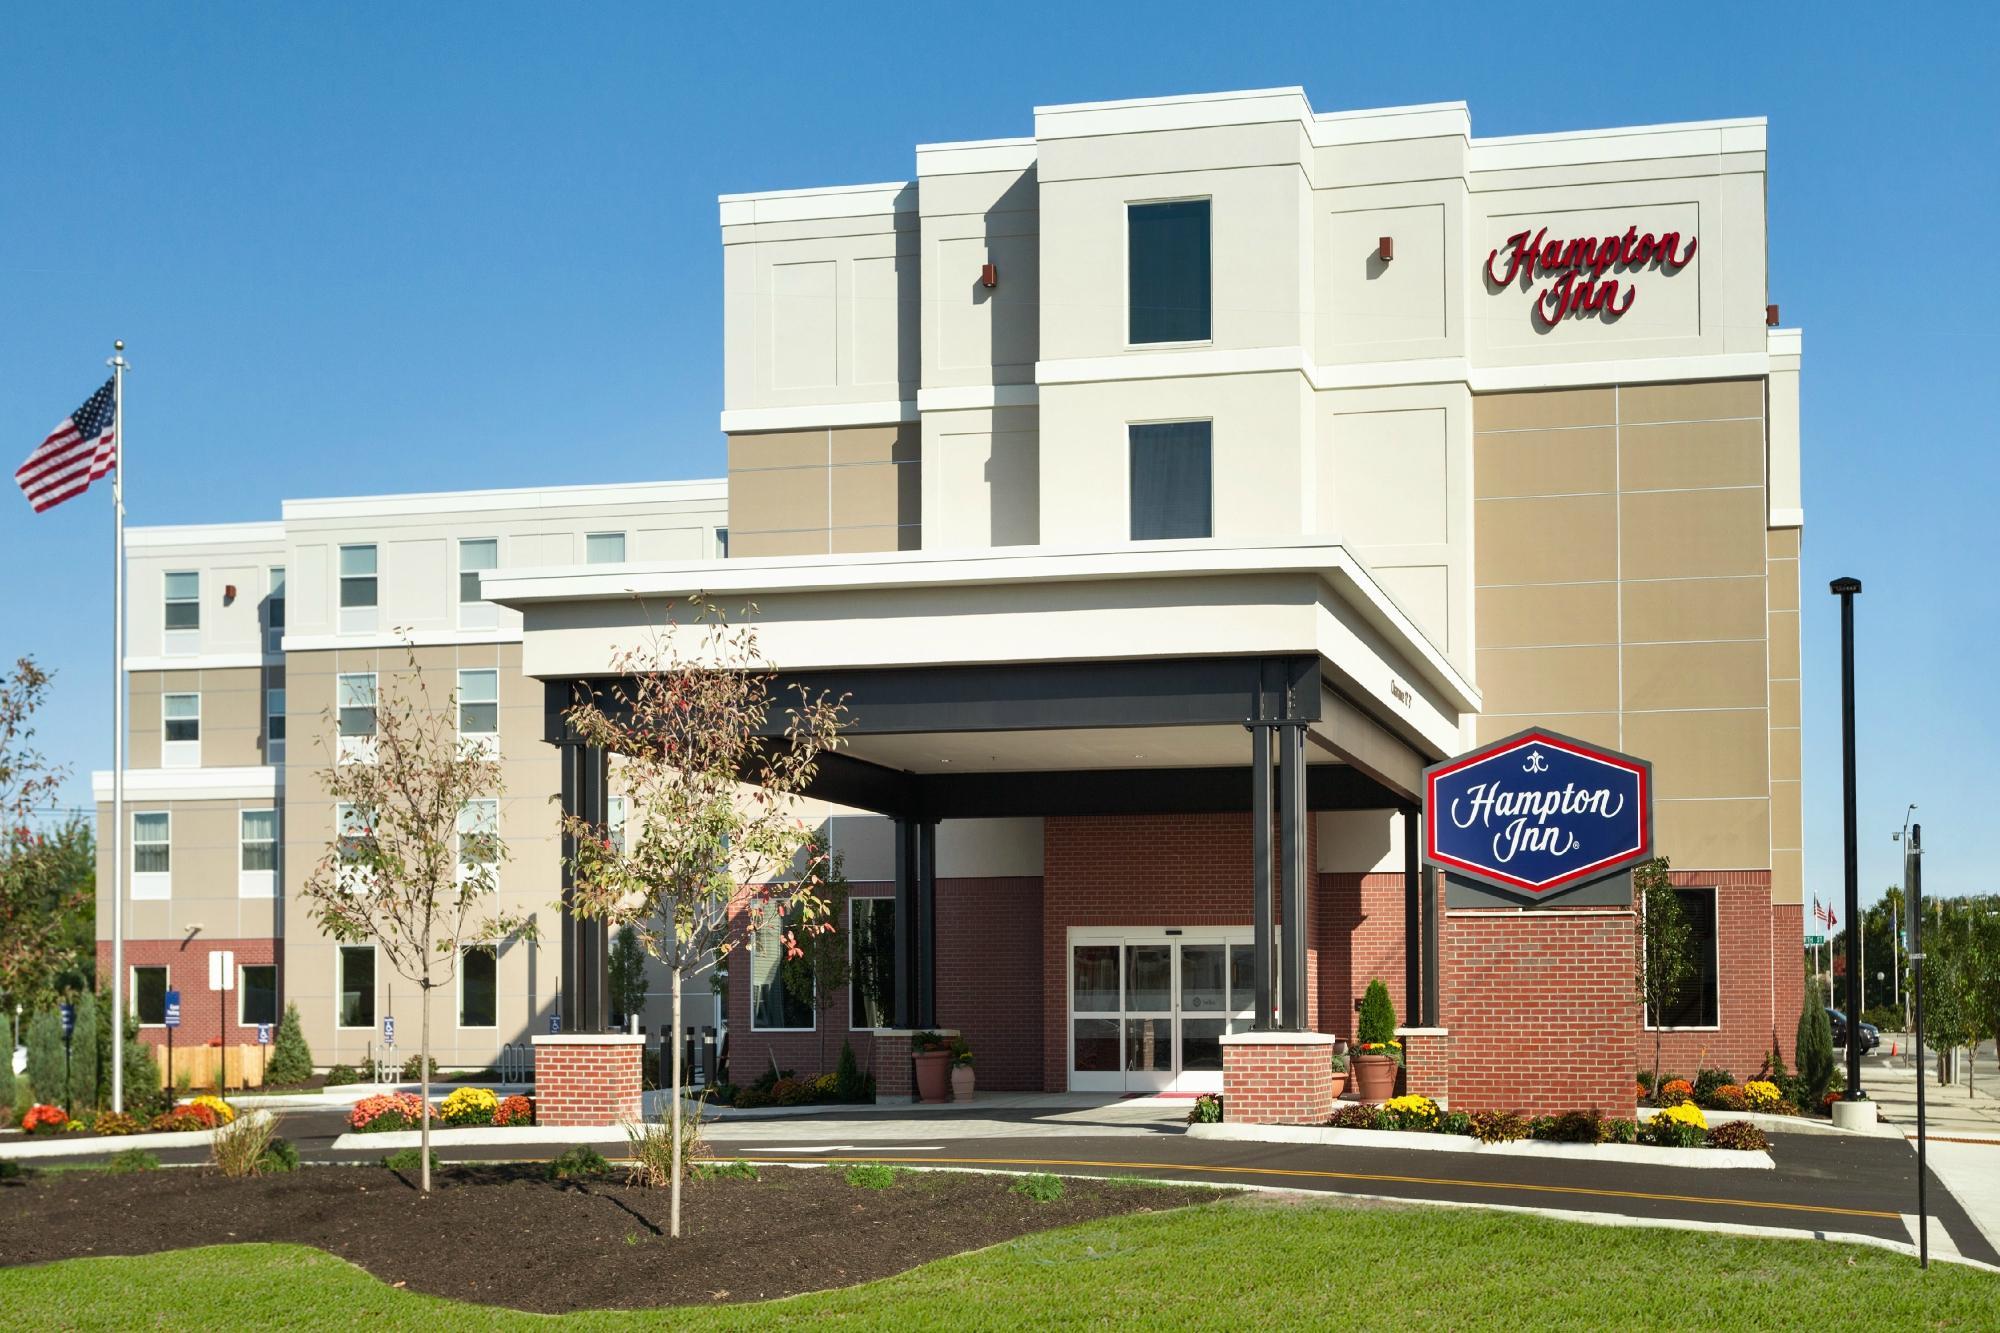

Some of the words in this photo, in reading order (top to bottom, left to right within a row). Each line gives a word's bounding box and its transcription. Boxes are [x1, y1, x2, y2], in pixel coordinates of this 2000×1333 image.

[1488, 226, 1697, 286] Hampton
[1538, 269, 1636, 327] Inn
[1451, 780, 1624, 829] Hampton
